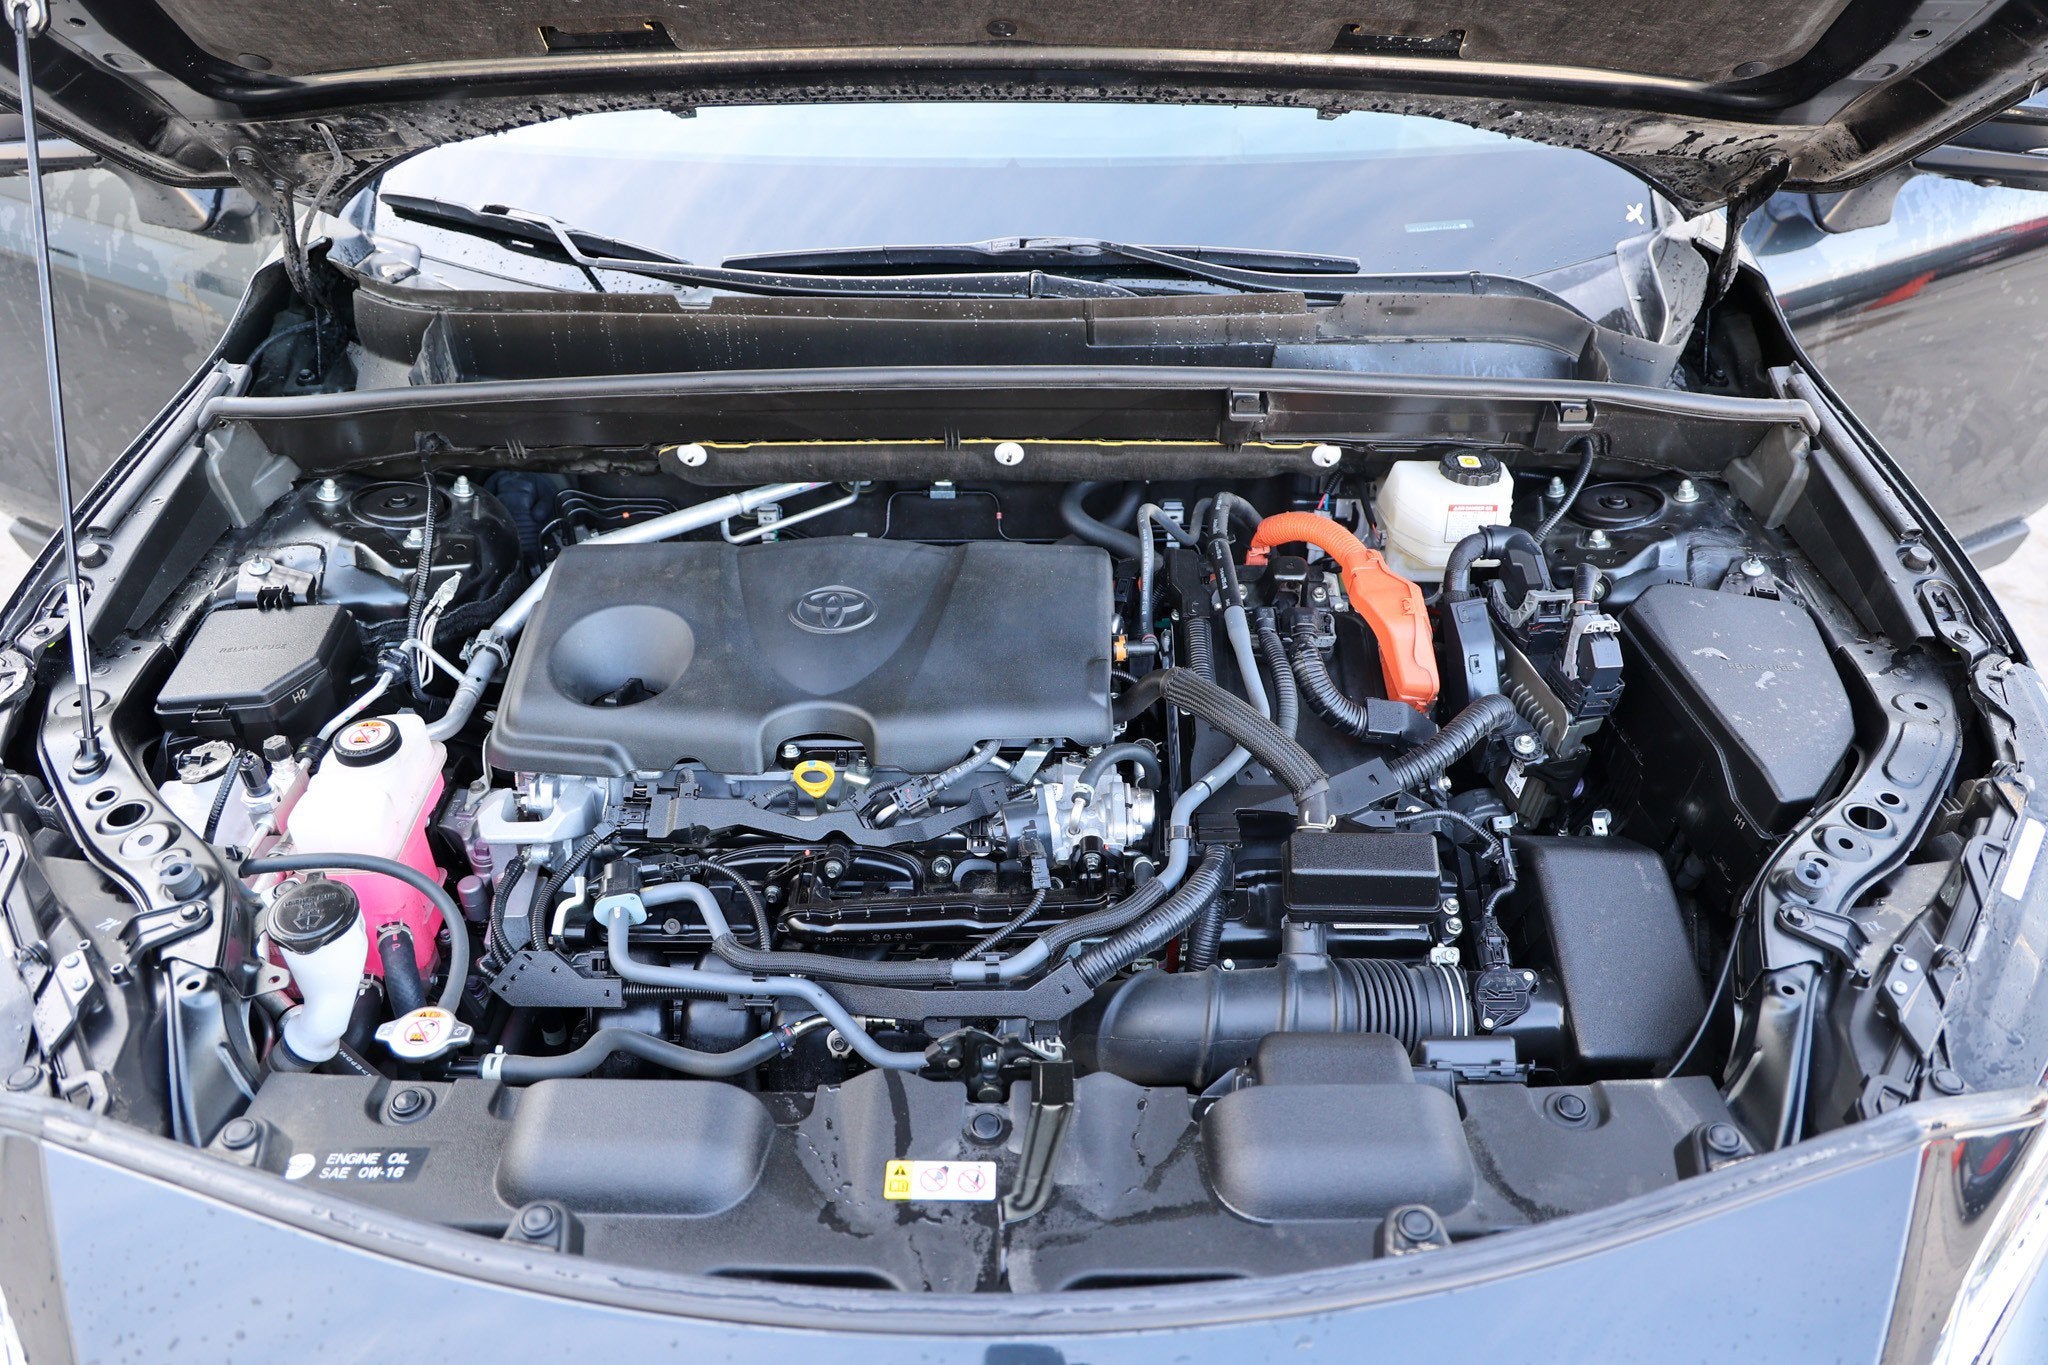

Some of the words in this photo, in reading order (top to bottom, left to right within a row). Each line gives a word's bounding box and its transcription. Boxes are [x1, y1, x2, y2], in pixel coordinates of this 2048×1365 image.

[292, 688, 307, 704] H2
[1733, 813, 1745, 829] H1
[326, 1152, 381, 1165] ENGINE
[387, 1152, 410, 1165] OIL
[319, 1167, 351, 1179] SAE
[358, 1166, 405, 1179] 0W-16
